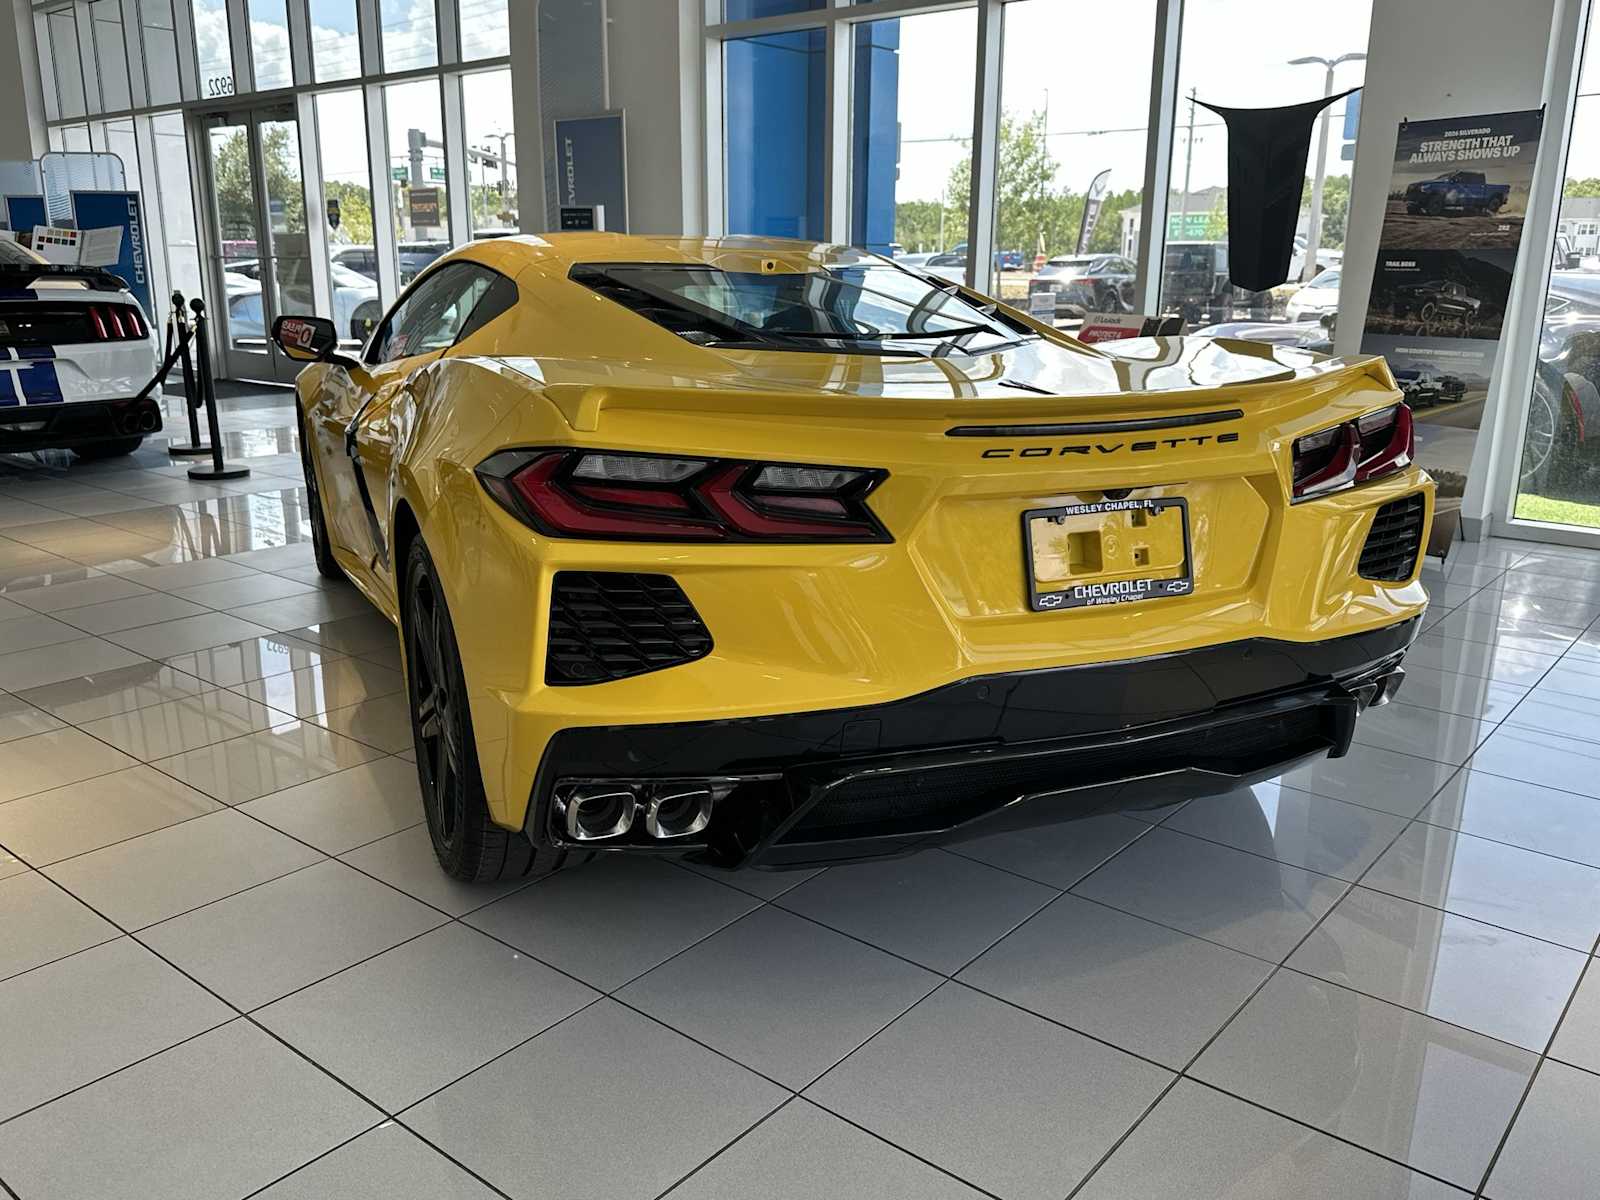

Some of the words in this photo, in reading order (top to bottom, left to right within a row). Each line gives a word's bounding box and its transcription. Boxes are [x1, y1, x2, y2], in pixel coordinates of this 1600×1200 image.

[1460, 128, 1491, 136] SILVERADO
[1420, 138, 1481, 152] STRENGTH
[1482, 135, 1514, 148] THAT
[1409, 150, 1456, 163] ALWAYS
[1457, 147, 1502, 160] SHOWS
[1503, 145, 1521, 157] UP
[565, 136, 576, 208] EVROLET
[127, 196, 145, 284] CHEVROLET
[981, 432, 1239, 459] CORVETTE
[1066, 503, 1102, 515] WESLEY
[1104, 501, 1142, 511] CHAPEL,
[1144, 500, 1154, 508] FL
[1074, 579, 1153, 599] CHEVROLET
[1087, 597, 1095, 605] of
[1096, 596, 1120, 605] Wesley
[1121, 593, 1144, 602] Chapel
